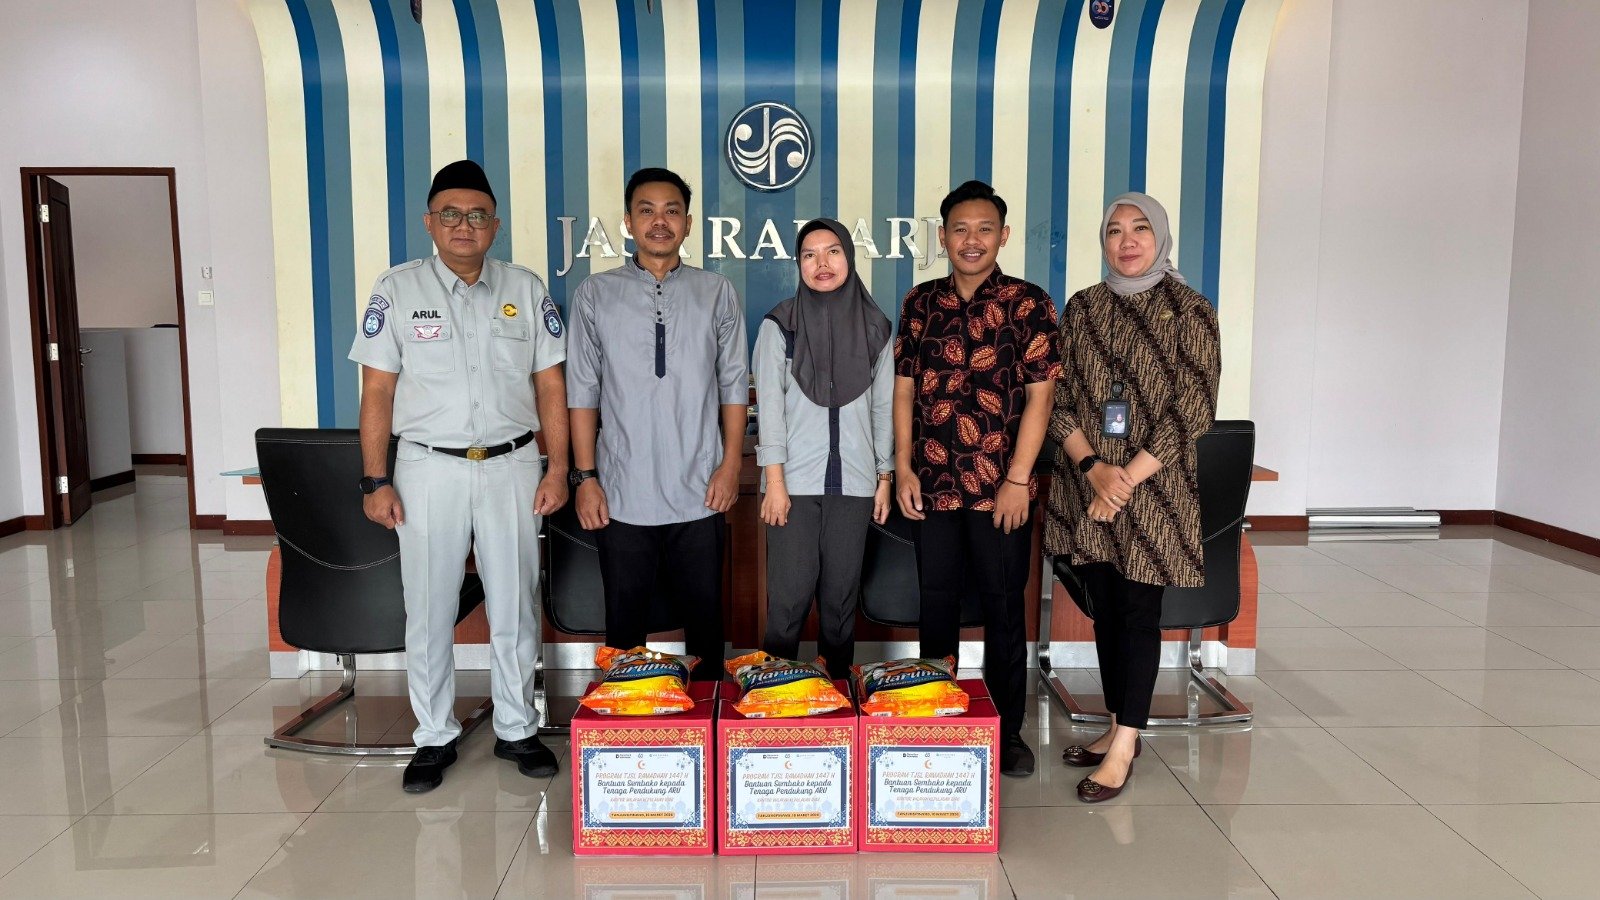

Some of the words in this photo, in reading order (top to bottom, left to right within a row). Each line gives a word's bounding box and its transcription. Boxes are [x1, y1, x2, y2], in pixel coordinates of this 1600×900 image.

[707, 216, 949, 271] RAARJ
[412, 310, 441, 320] ARUL
[597, 779, 625, 787] Bantuan
[627, 779, 659, 787] Sembako
[660, 779, 685, 788] kepada
[744, 780, 772, 788] Bantuan
[774, 779, 805, 787] Sembako
[806, 779, 832, 788] kepada
[884, 778, 912, 786] Bantuan
[913, 778, 944, 786] Sembako
[946, 778, 972, 788] kepada
[603, 787, 628, 796] Tenaga
[629, 787, 667, 796] Pendukung
[749, 788, 774, 796] Tenaga
[775, 787, 813, 796] Pendukung
[889, 786, 914, 794] Tenaga
[915, 786, 953, 795] Pendukung
[954, 786, 967, 794] ARU
